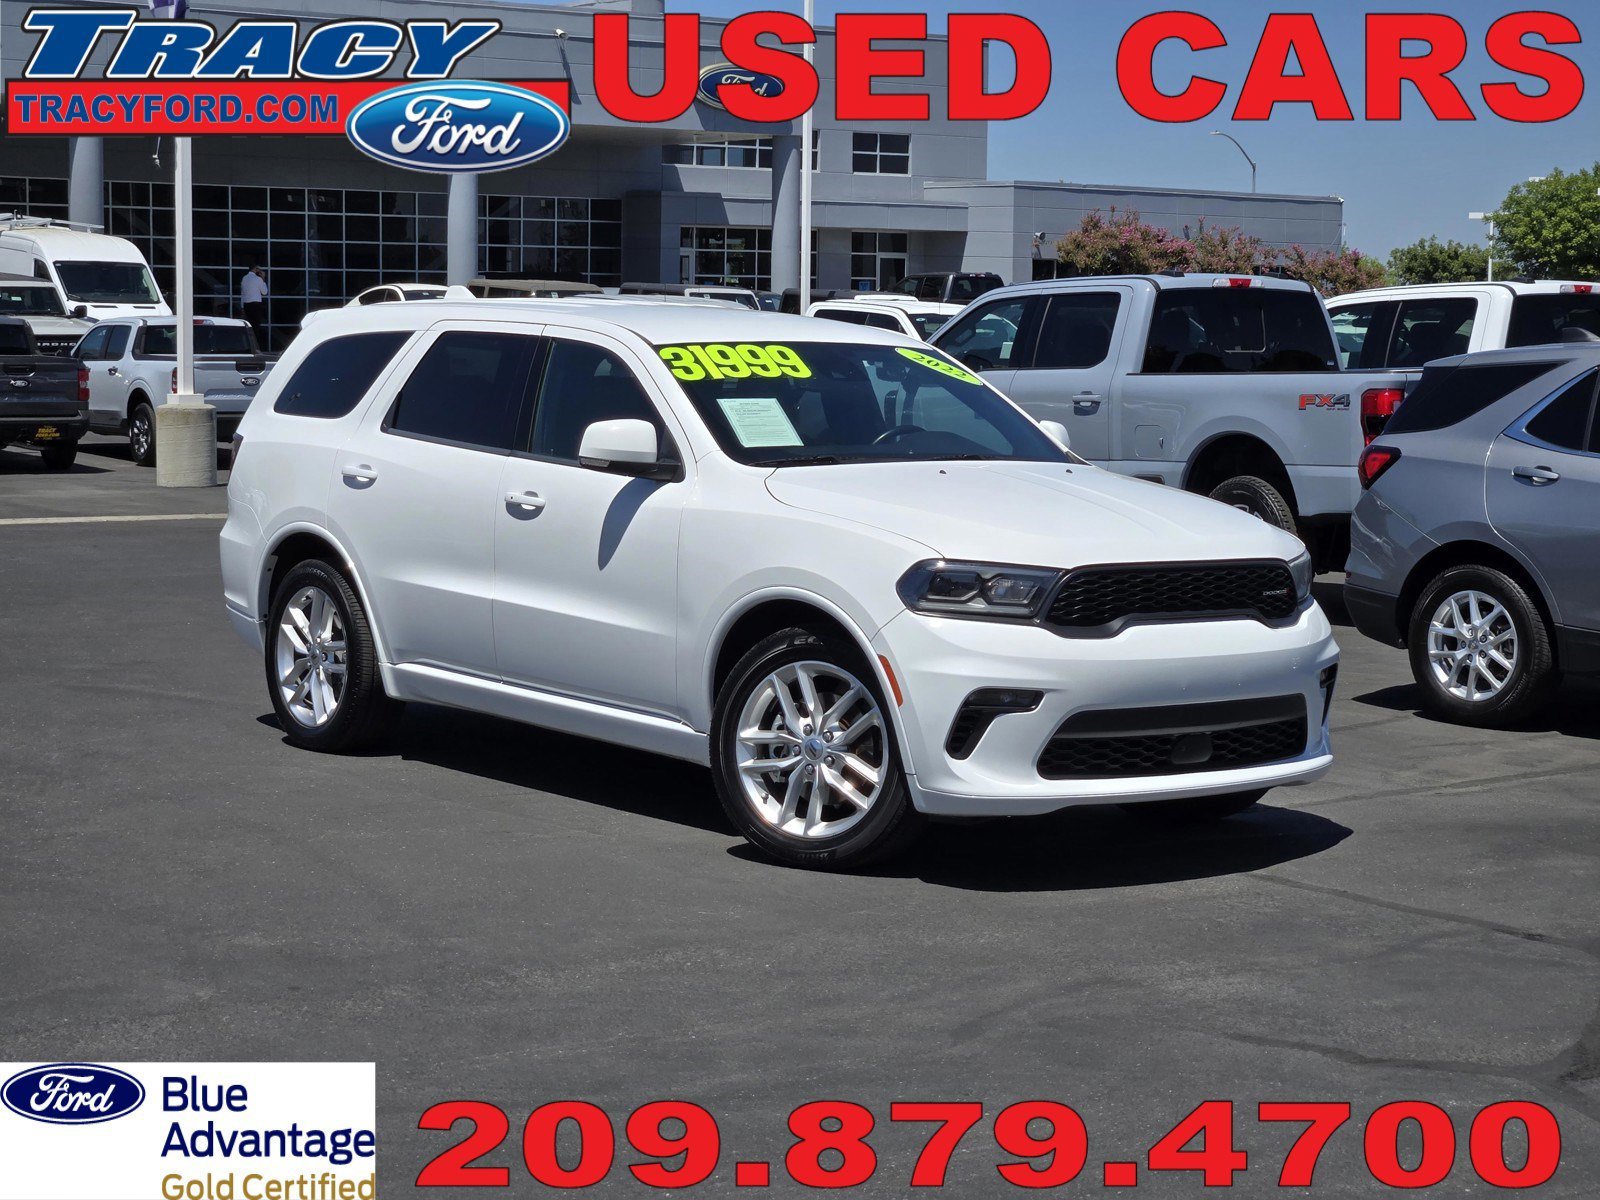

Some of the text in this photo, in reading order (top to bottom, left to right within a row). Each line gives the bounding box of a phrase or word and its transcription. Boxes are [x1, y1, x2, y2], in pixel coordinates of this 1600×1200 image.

[659, 344, 812, 381] 31999
[913, 353, 967, 378] 2022
[1298, 394, 1351, 410] FX4
